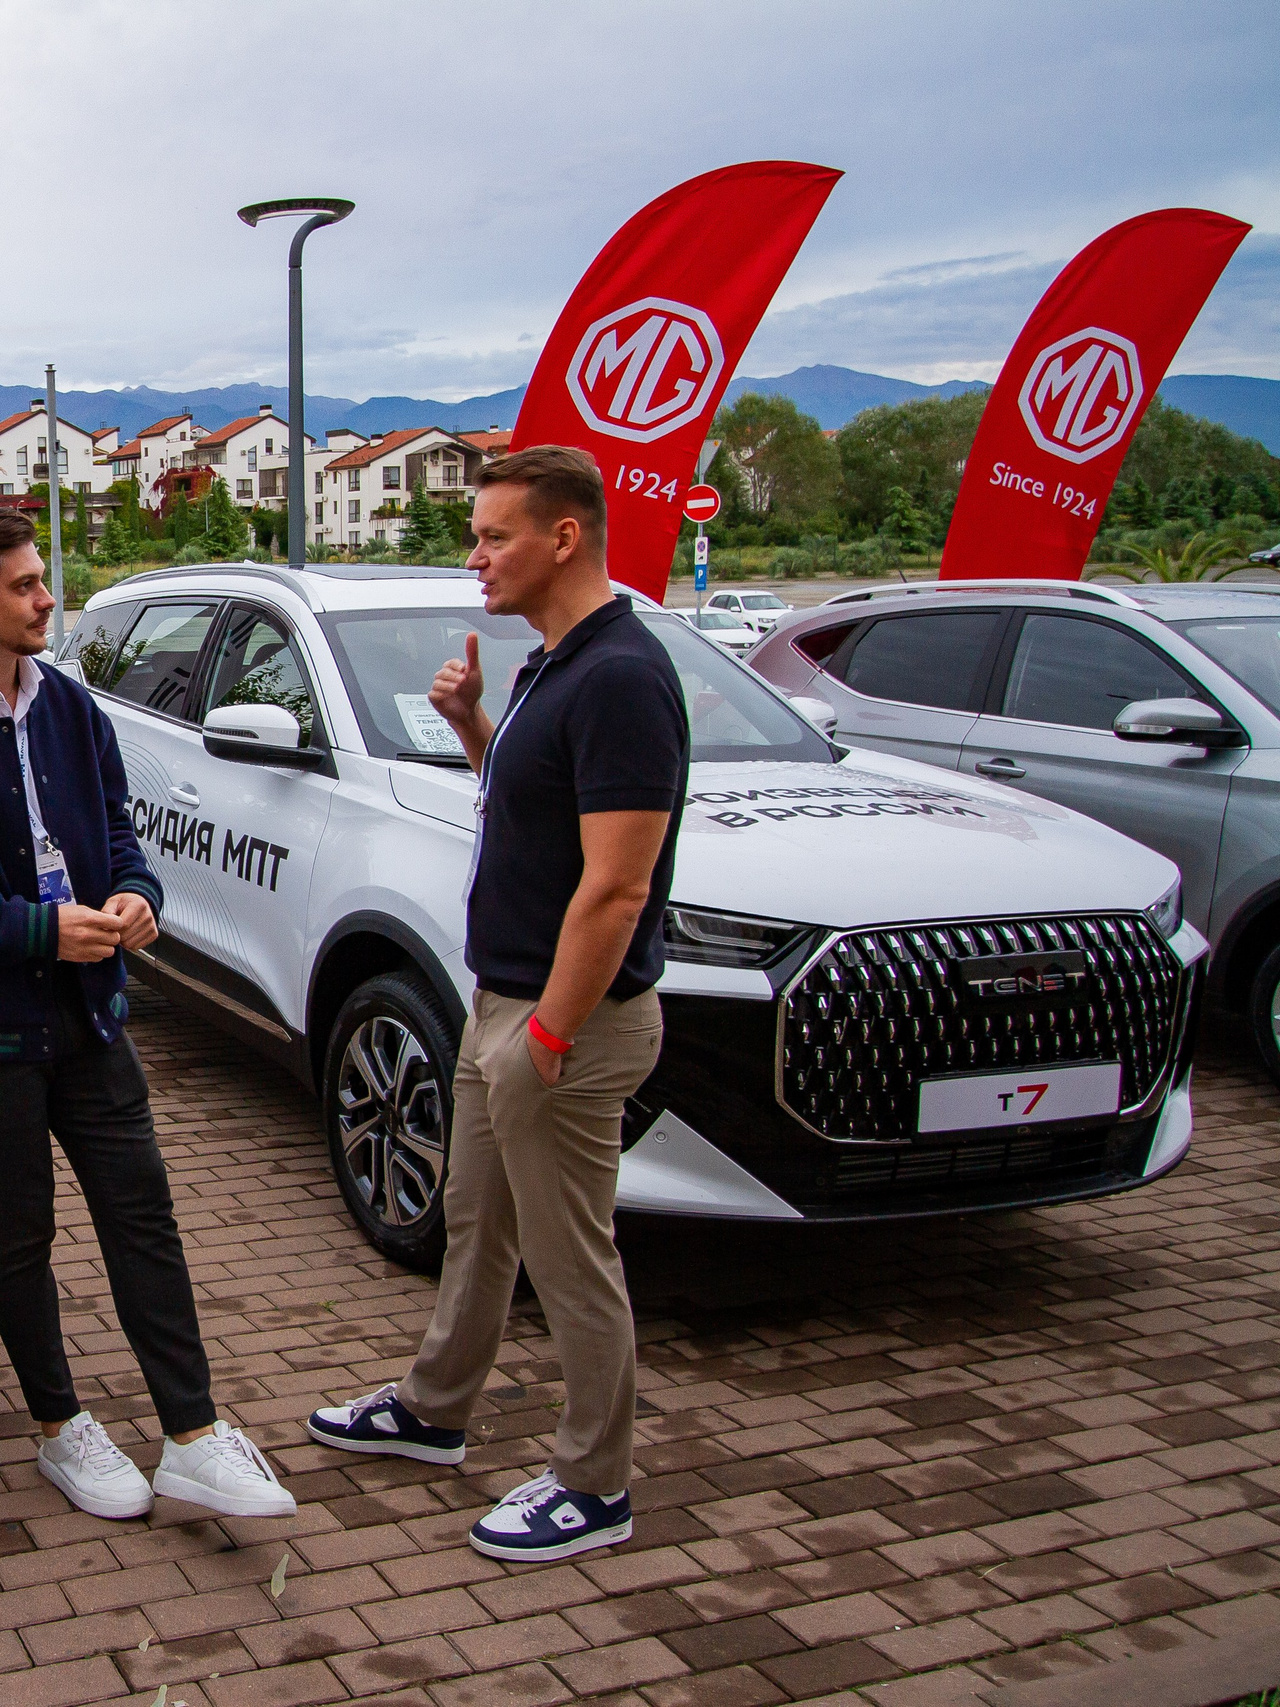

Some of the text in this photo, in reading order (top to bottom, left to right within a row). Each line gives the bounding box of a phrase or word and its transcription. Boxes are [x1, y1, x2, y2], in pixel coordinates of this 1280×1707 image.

[584, 314, 706, 426] MG
[1034, 343, 1129, 448] MG
[614, 464, 679, 504] 1924
[989, 461, 1098, 521] Since 1924
[697, 569, 704, 579] P
[705, 811, 760, 829] В
[221, 828, 291, 893] МПТ
[967, 971, 1087, 997] TENET
[997, 1082, 1050, 1116] T7
